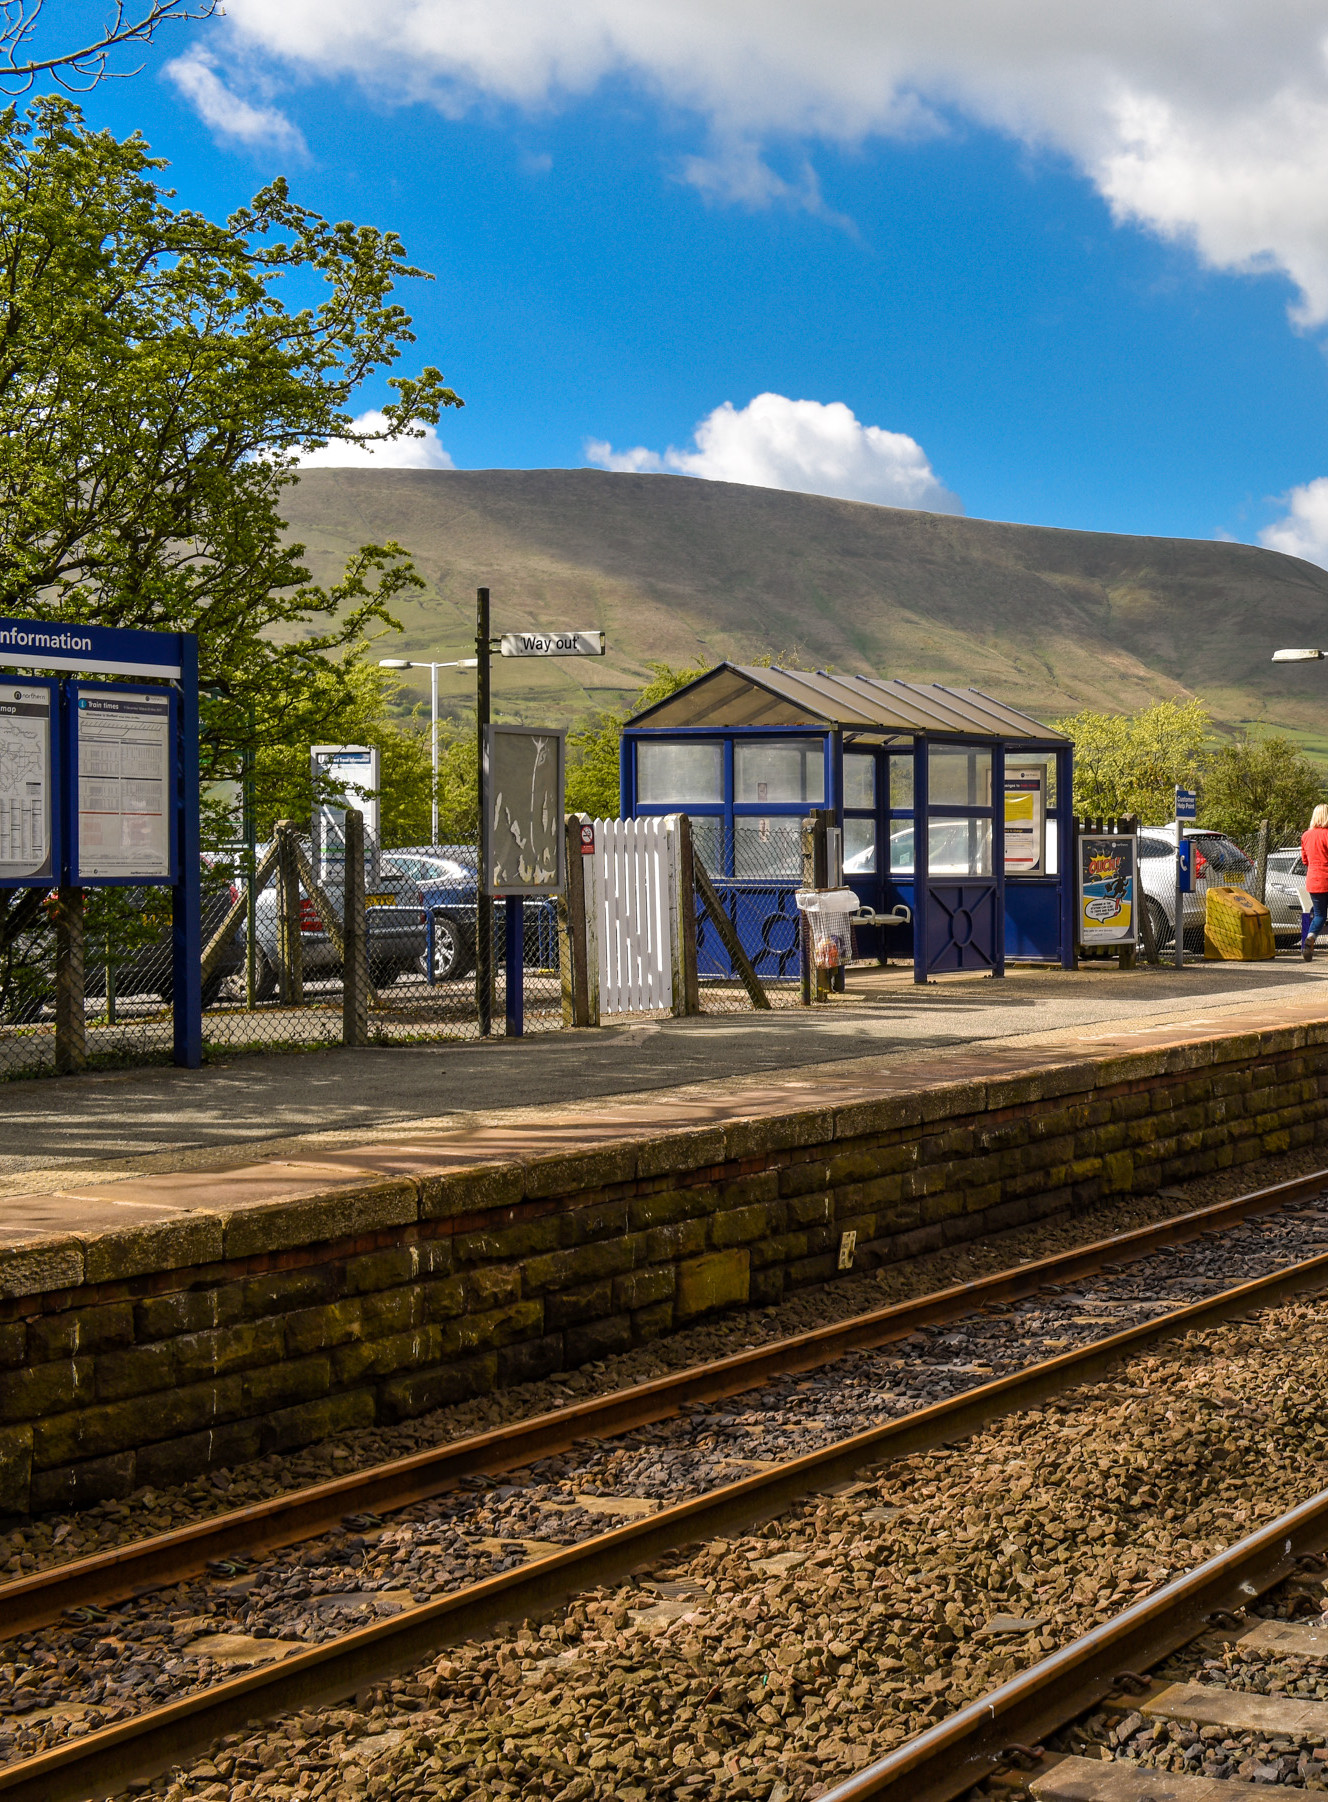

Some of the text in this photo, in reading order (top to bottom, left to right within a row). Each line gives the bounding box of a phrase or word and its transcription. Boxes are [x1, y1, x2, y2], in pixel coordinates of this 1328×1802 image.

[522, 636, 578, 652] Way out
[0, 706, 17, 714] map
[103, 702, 119, 710] times
[1089, 857, 1121, 874] OUCH!
